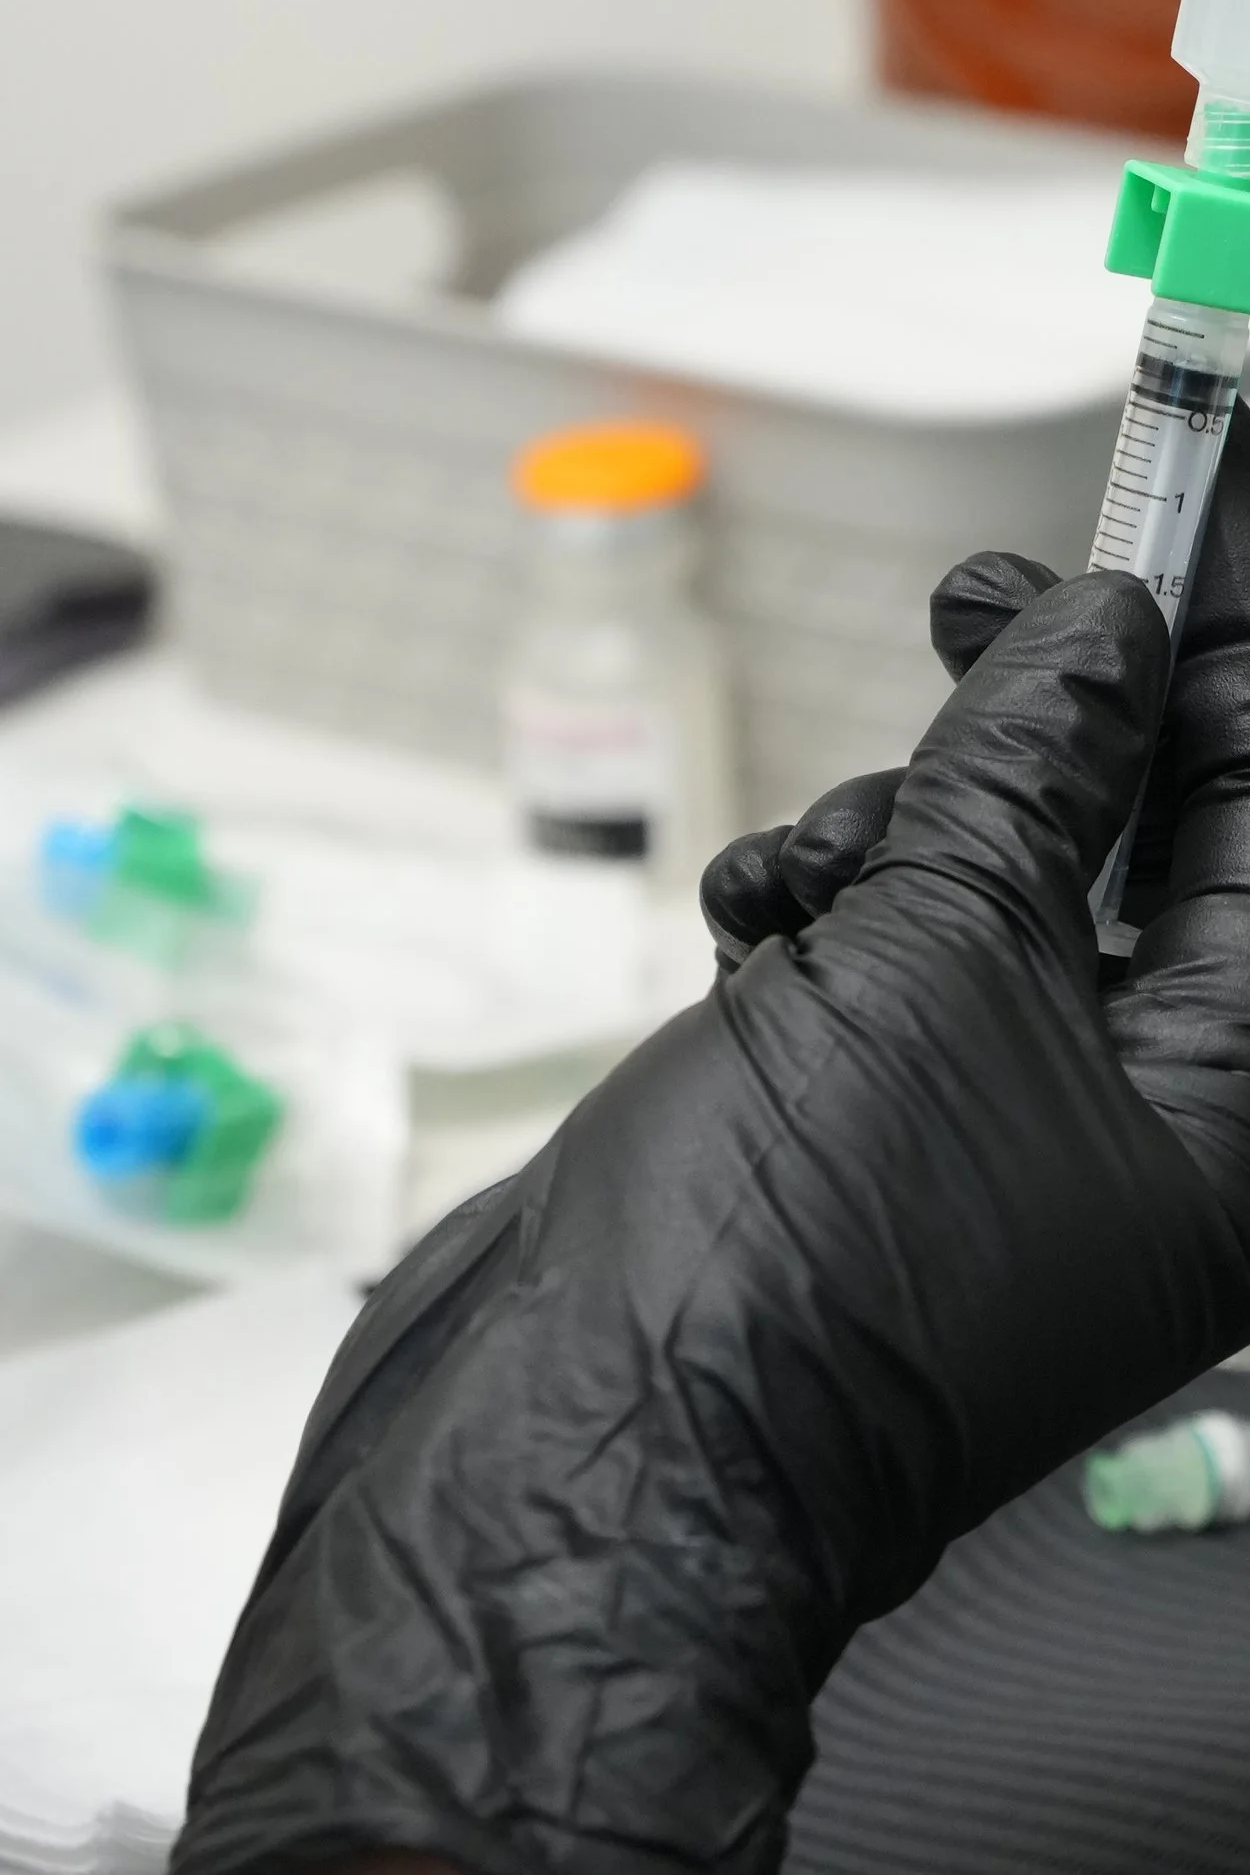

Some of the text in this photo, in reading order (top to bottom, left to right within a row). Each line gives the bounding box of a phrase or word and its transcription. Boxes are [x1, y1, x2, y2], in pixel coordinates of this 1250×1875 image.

[1188, 409, 1224, 436] 0.5
[1174, 492, 1185, 514] 1
[1154, 573, 1185, 599] 1.5
